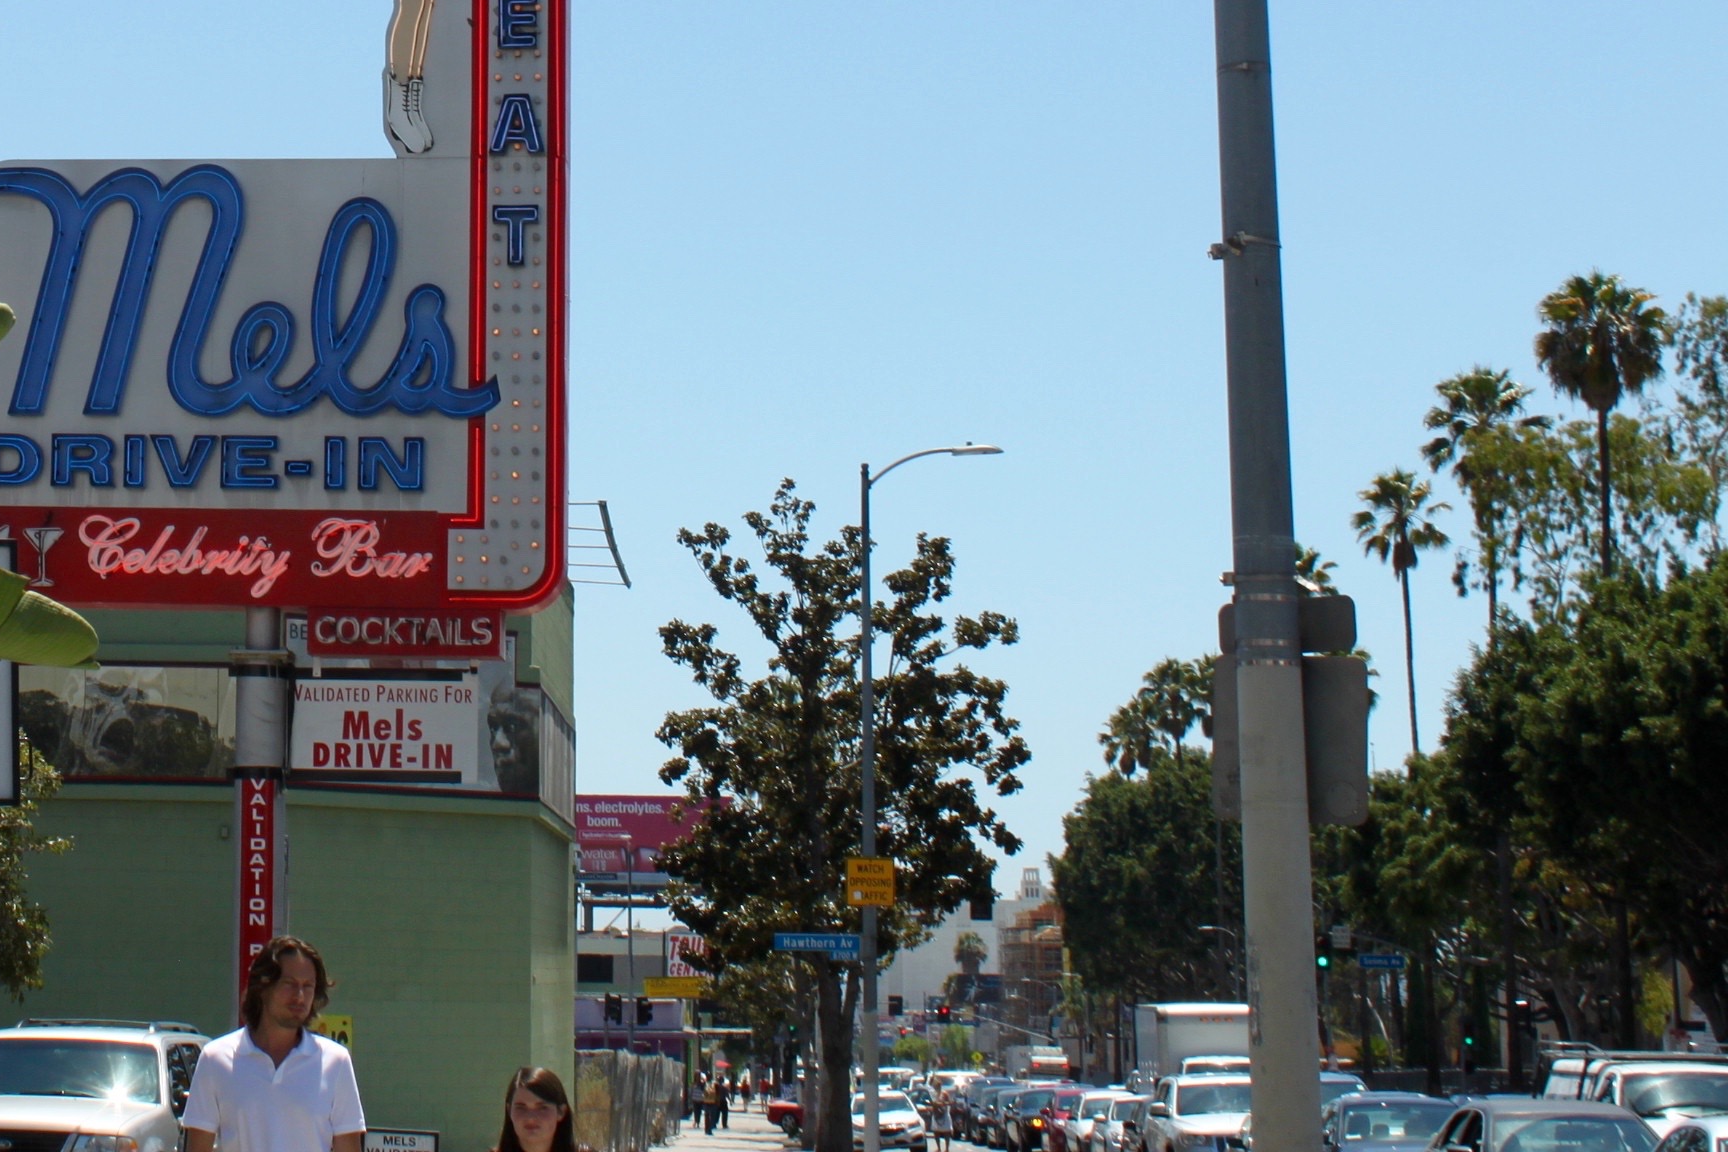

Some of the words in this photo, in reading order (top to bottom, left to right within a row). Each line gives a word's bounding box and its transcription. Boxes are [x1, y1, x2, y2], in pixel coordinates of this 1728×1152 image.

[78, 514, 292, 598] Celebrity
[310, 517, 433, 579] Bar
[314, 614, 494, 646] COCKTAILS
[294, 683, 370, 703] VALIDATED
[376, 685, 439, 703] PARKING
[444, 686, 473, 704] FOR
[342, 708, 424, 741] Mels
[313, 742, 453, 769] DRIVE-IN
[595, 801, 665, 816] electrolytes.
[587, 815, 622, 827] boom.
[249, 778, 267, 926] VALIDATION
[856, 864, 884, 874] WATCH
[849, 877, 892, 888] OPPOSING
[783, 937, 836, 948] Hawthorn
[840, 938, 853, 948] Av
[383, 1135, 416, 1146] MELS
